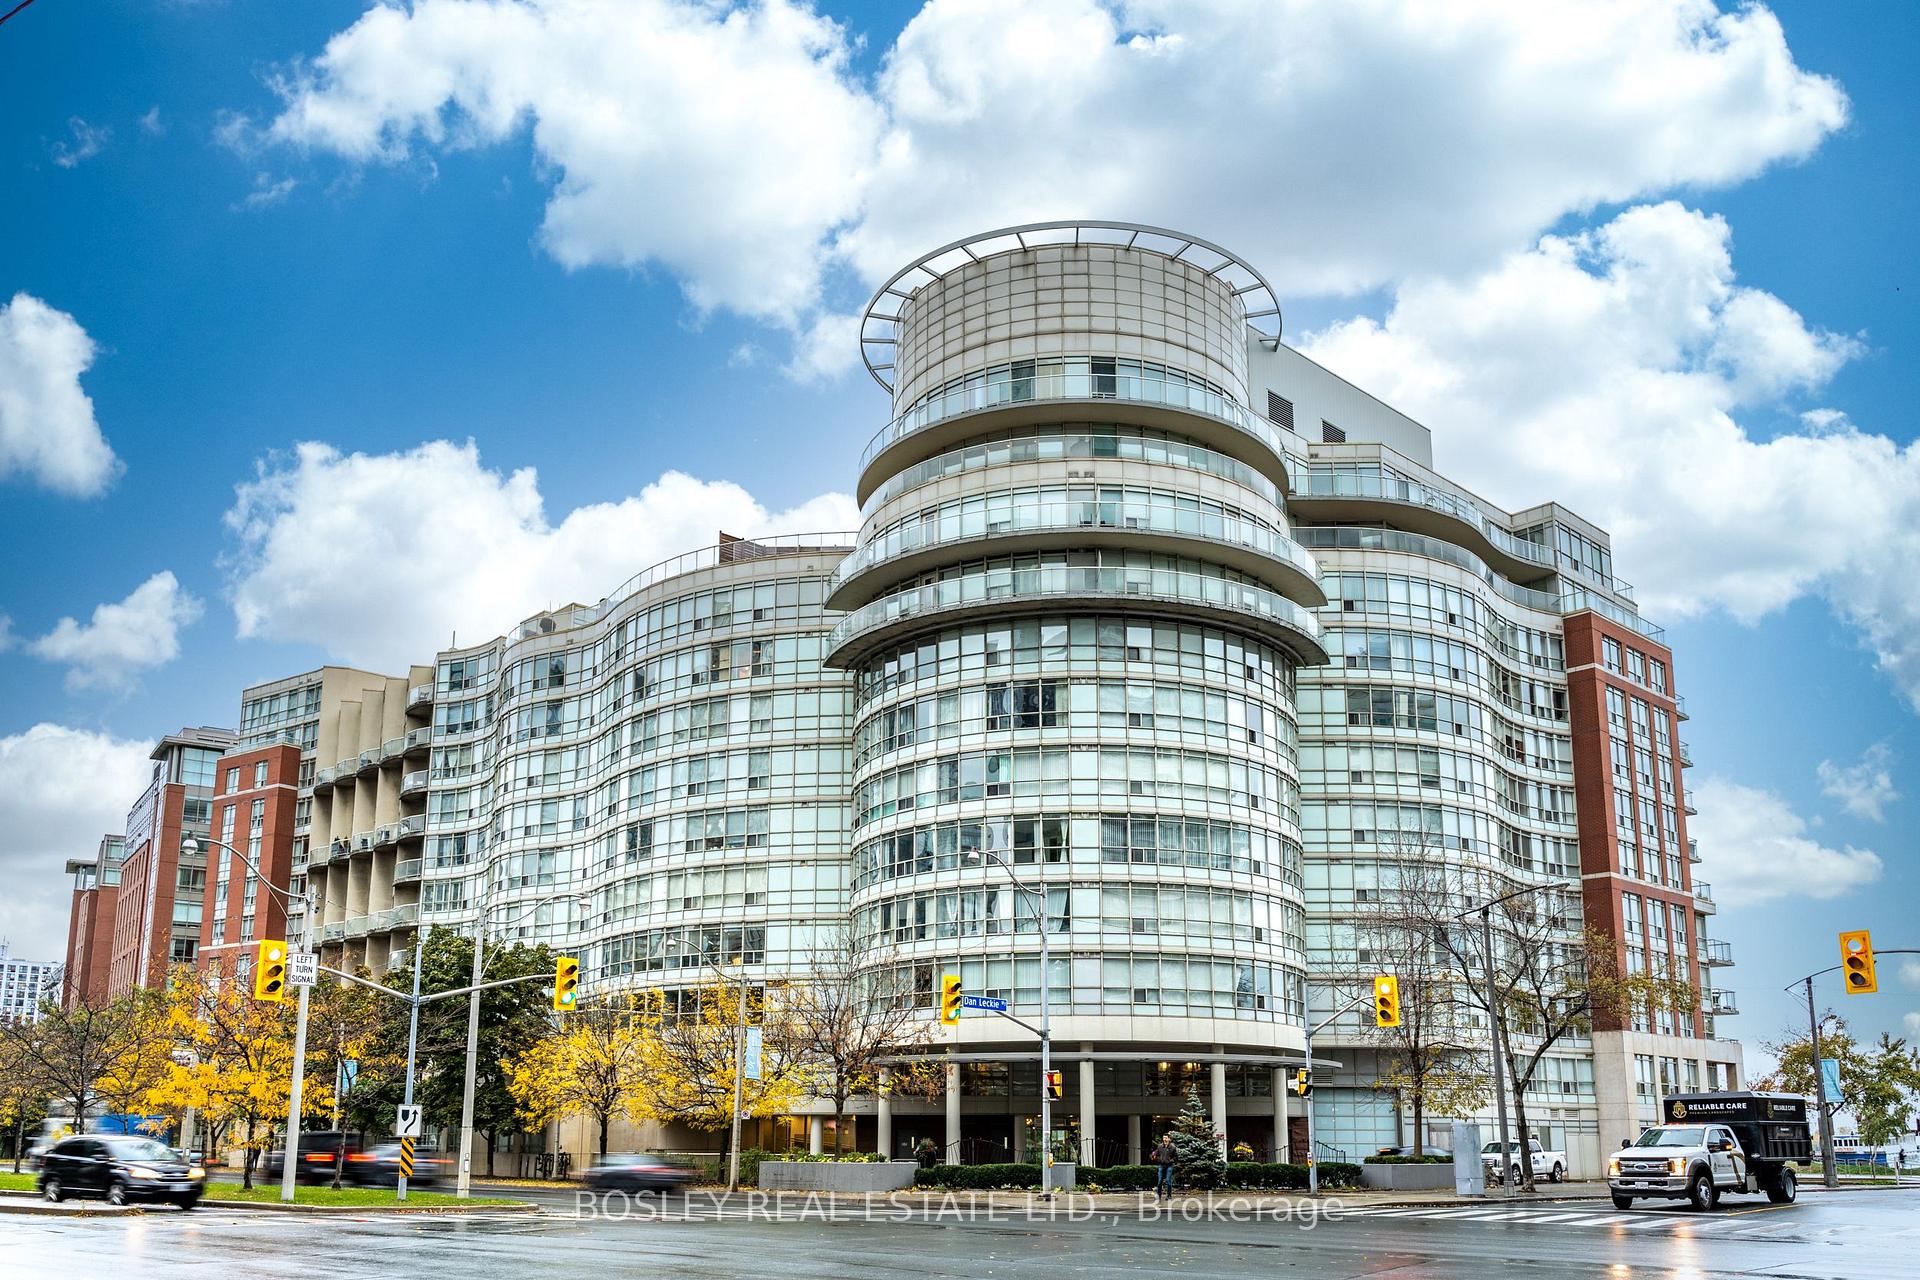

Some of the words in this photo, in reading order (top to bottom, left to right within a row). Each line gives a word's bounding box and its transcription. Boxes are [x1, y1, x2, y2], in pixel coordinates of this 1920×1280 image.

[296, 956, 313, 964] LEFT
[296, 965, 314, 974] TURN
[292, 975, 315, 984] SIGNAL
[964, 997, 976, 1006] Dan
[979, 998, 1000, 1008] Leckie
